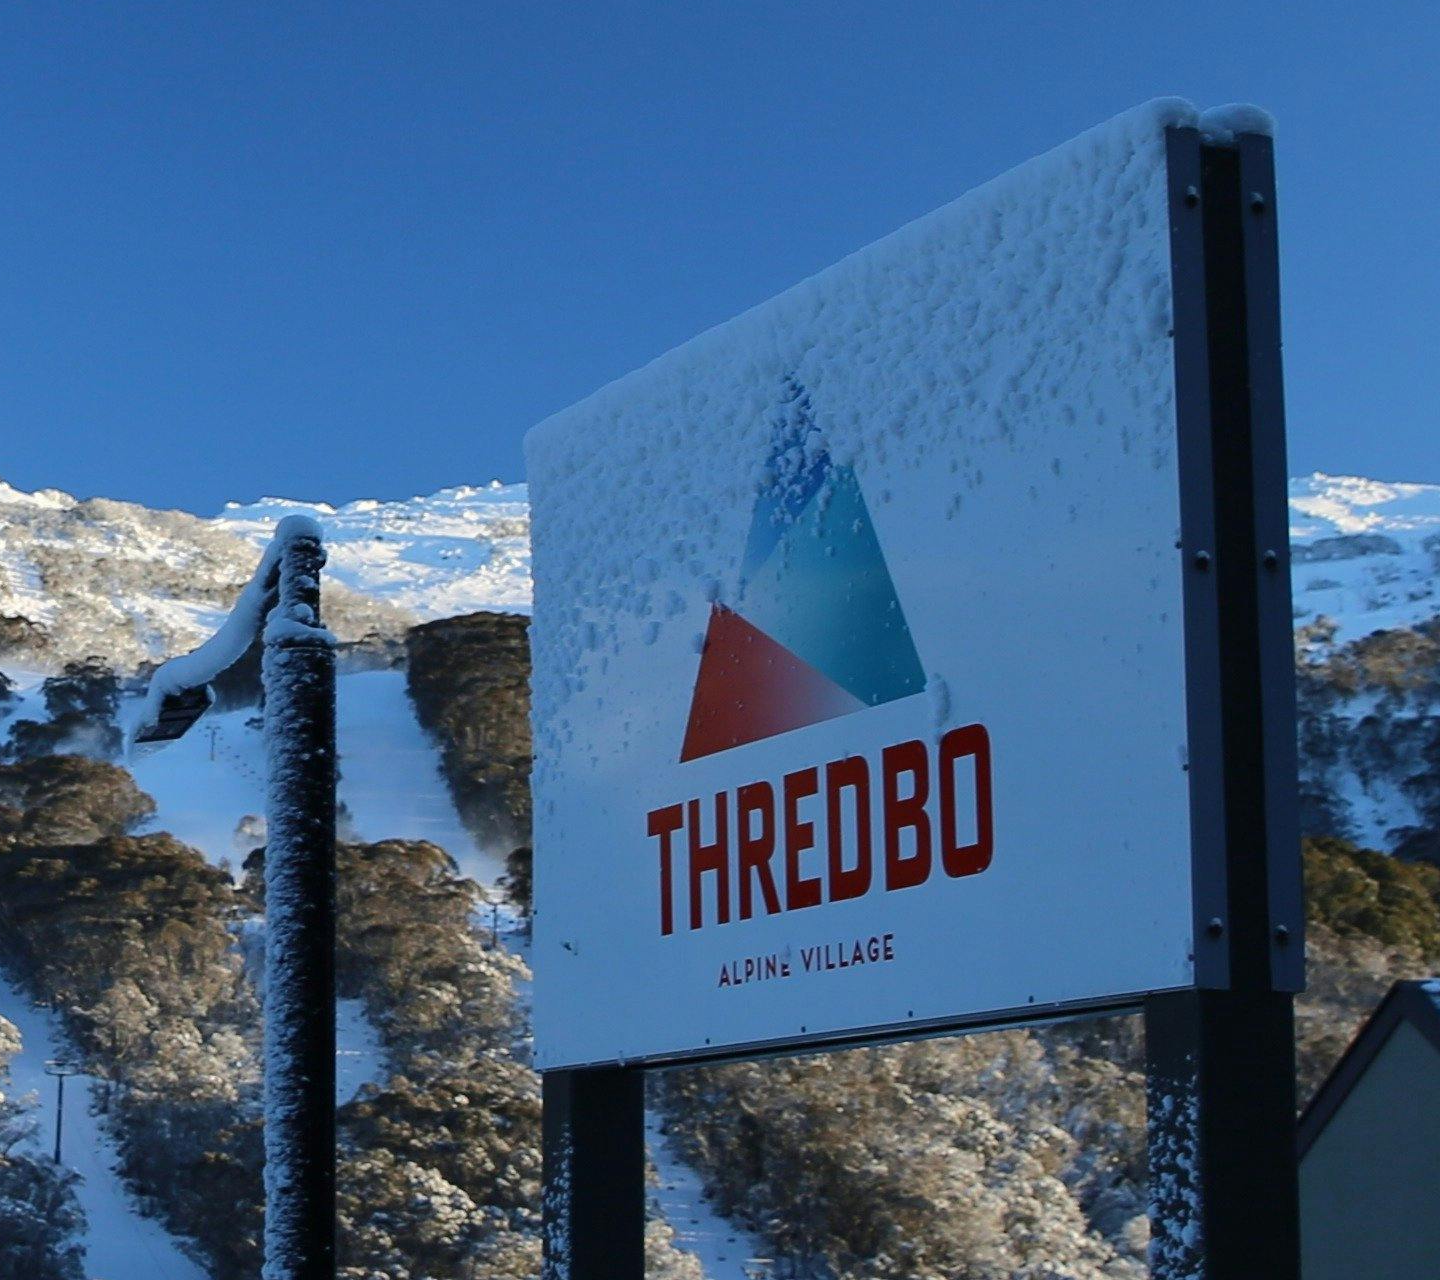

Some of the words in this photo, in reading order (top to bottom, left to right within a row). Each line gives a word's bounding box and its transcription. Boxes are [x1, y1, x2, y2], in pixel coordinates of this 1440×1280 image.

[647, 723, 994, 936] THREDBO
[718, 953, 791, 988] ALPINE
[801, 933, 895, 973] VILLAGE
